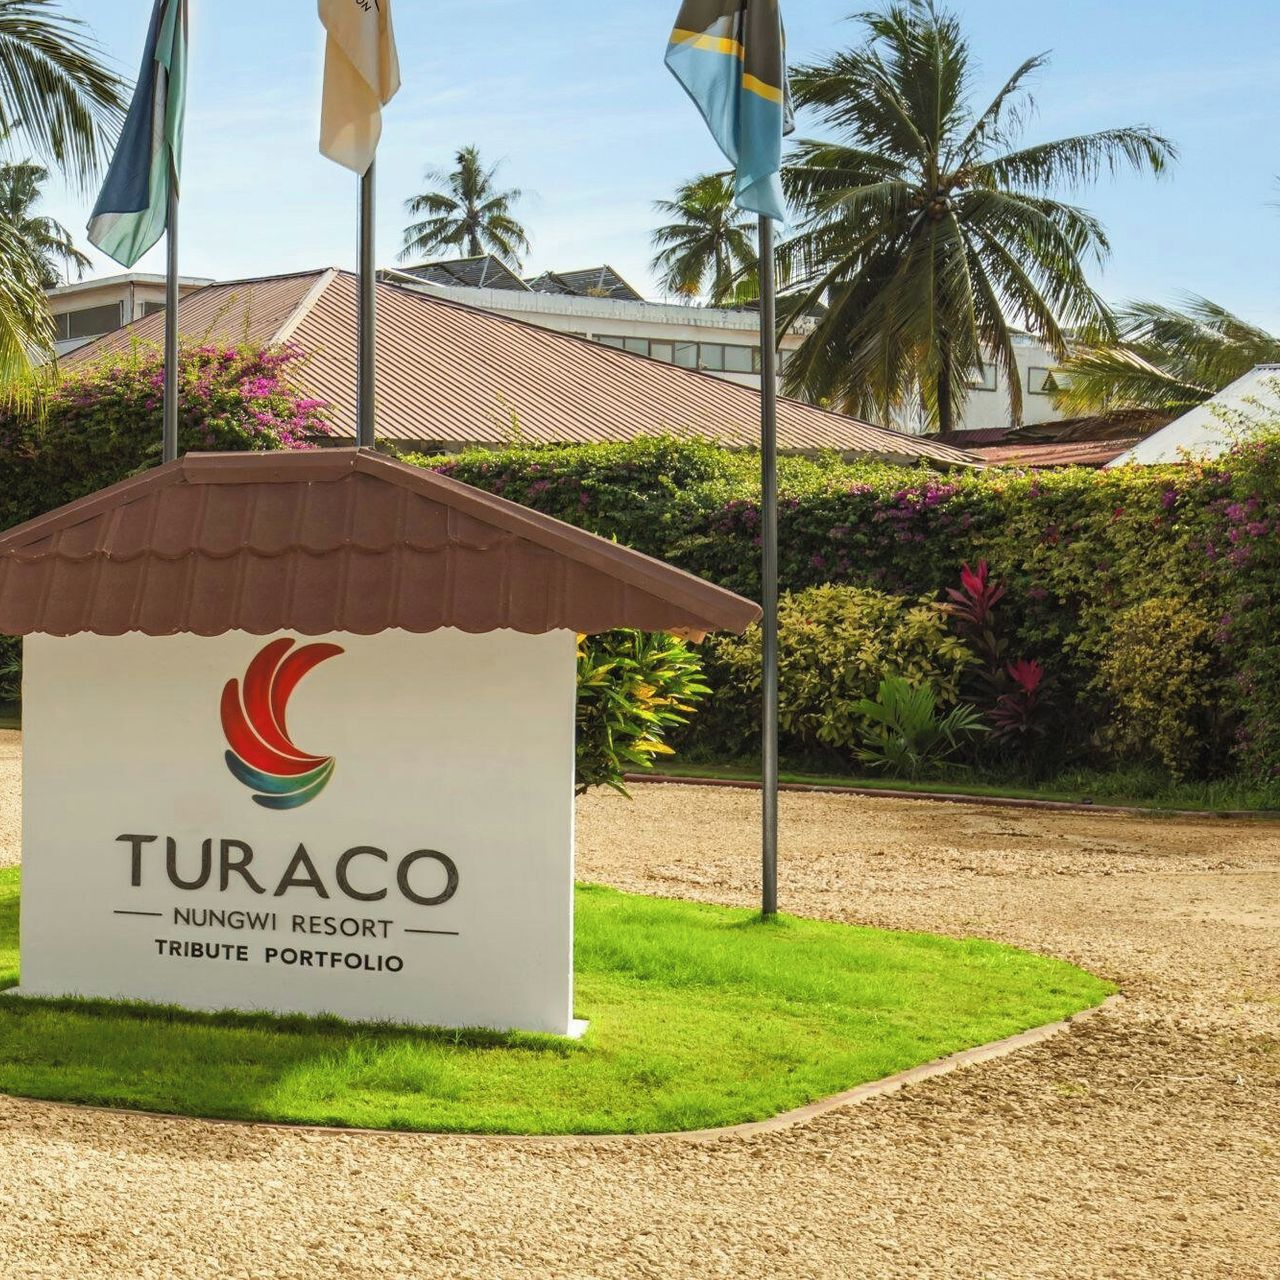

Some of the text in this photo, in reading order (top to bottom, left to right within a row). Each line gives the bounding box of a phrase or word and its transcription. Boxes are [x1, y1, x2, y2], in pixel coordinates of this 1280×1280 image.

[115, 832, 460, 907] TURACO
[173, 907, 394, 939] NUNGWI RESORT
[154, 938, 405, 974] TRIBUTE PORTFOLIO
